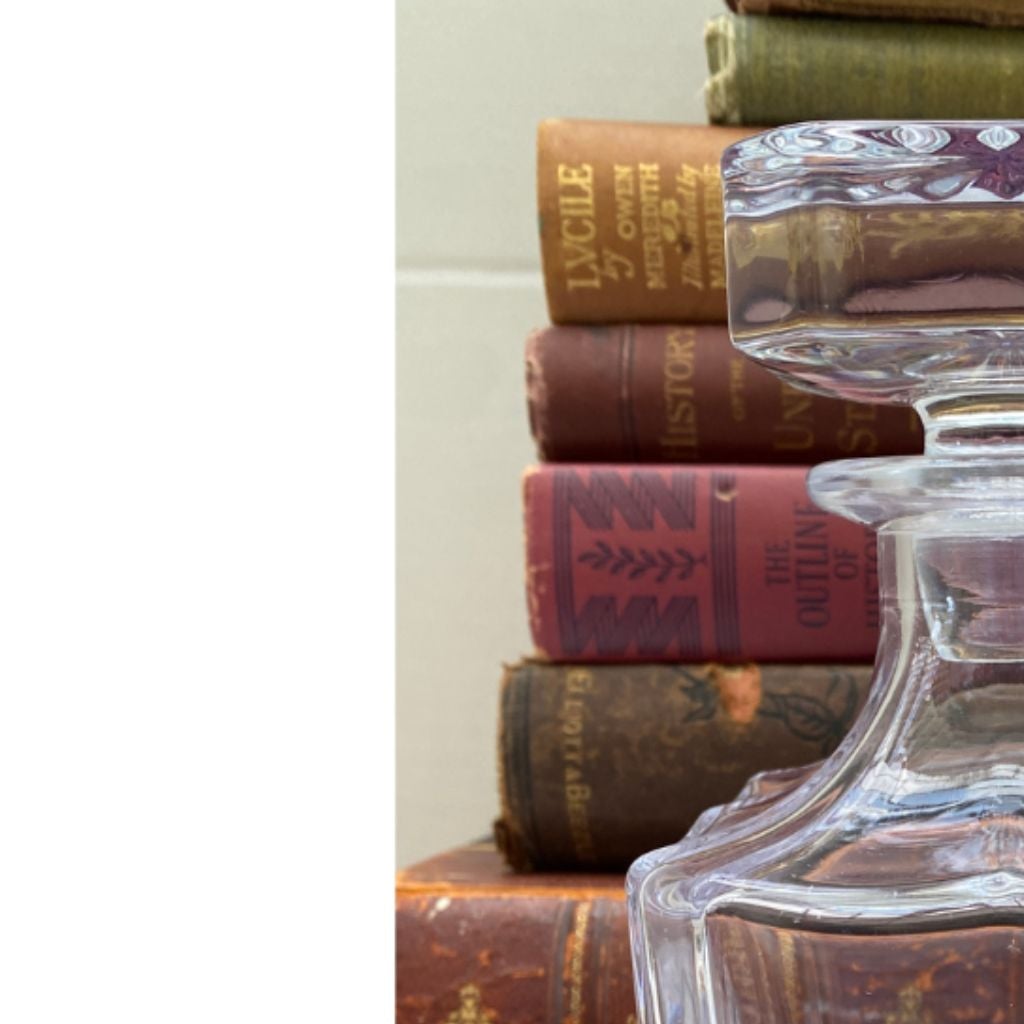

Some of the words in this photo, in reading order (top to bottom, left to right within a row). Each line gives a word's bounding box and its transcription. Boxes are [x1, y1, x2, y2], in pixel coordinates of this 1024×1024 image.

[557, 162, 602, 291] LVCILE
[613, 163, 636, 241] OWEN
[638, 162, 667, 290] MEREDITH
[764, 539, 792, 587] THE
[834, 546, 860, 582] OF
